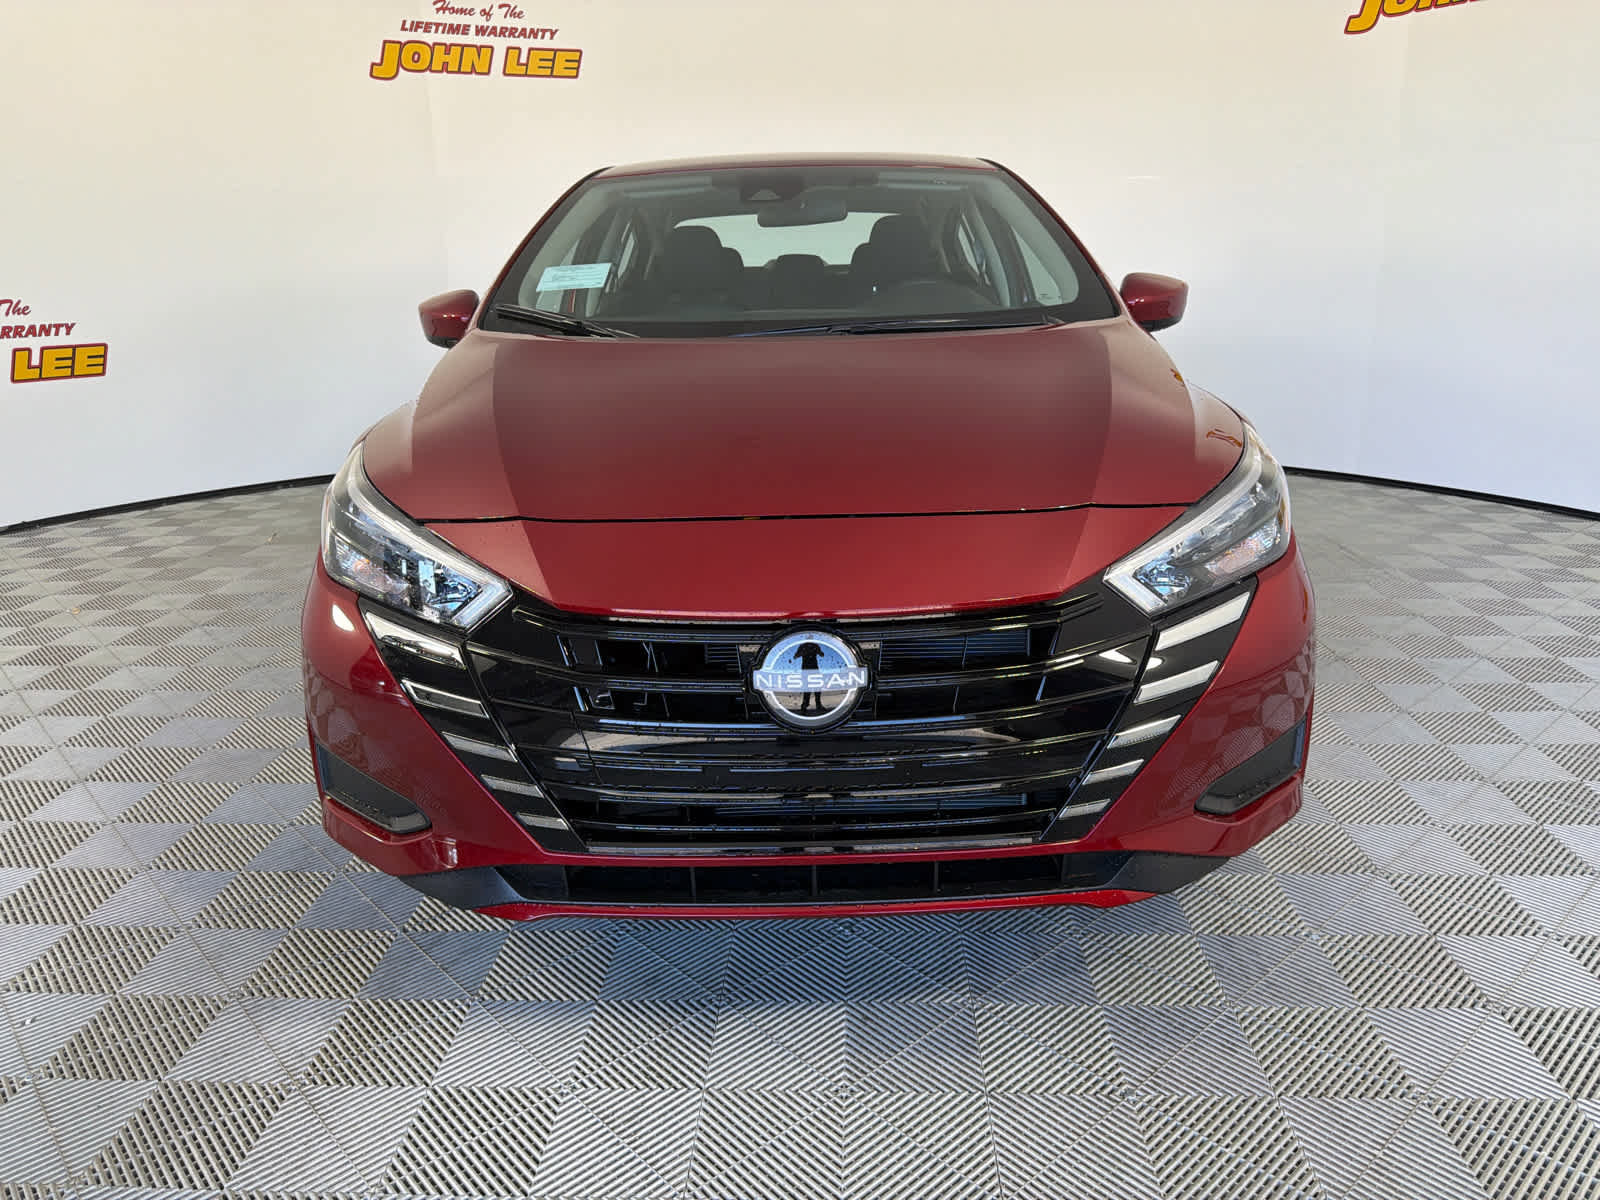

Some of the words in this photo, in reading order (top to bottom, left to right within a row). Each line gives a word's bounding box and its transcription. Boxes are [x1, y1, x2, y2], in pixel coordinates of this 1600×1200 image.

[432, 0, 475, 16] Home
[480, 4, 493, 22] of
[498, 3, 524, 19] The
[400, 19, 470, 36] LIFETIME
[475, 25, 559, 40] WARRANTY
[370, 40, 494, 80] JOHN
[502, 47, 583, 79] LEE
[0, 298, 31, 317] The
[10, 342, 108, 384] LEE
[755, 670, 866, 689] NISSAN
